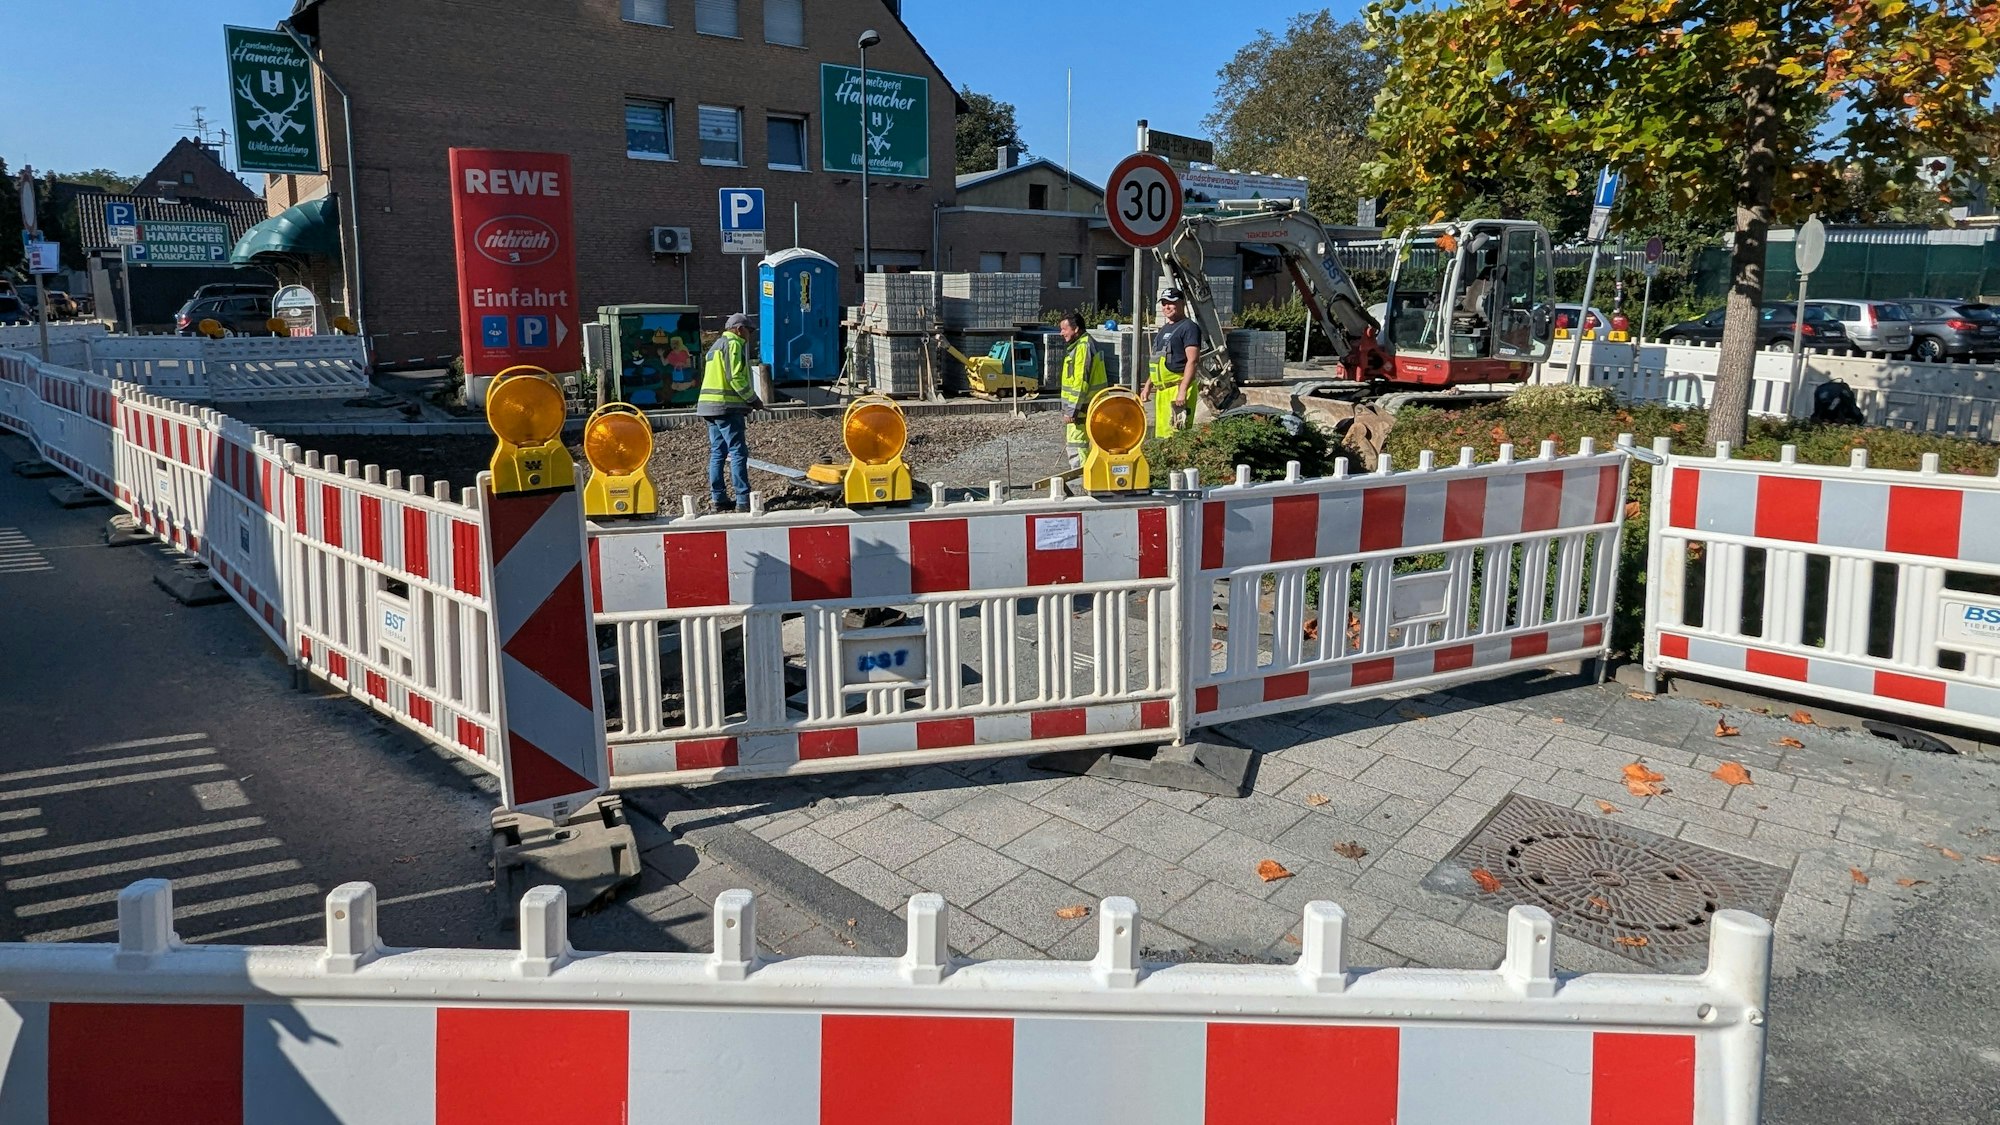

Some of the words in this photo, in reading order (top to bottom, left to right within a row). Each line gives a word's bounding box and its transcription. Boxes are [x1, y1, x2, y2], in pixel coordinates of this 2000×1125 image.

[239, 39, 294, 54] Landmetzgerei
[232, 47, 308, 67] Hamacher
[844, 71, 902, 92] Lanmetzgerei
[248, 141, 309, 157] Wildveredelung
[851, 153, 904, 172] Wilveredelung
[465, 168, 560, 197] REWE
[1124, 180, 1166, 222] 30
[113, 206, 128, 224] P
[731, 193, 753, 228] P
[145, 224, 223, 233] LANDMETZGEREI
[146, 232, 224, 243] HAMACHER
[484, 229, 550, 248] richrath
[132, 245, 145, 258] P
[150, 244, 206, 253] KUNDEN
[151, 252, 207, 260] PARKPLATZ
[211, 246, 223, 259] P
[1322, 258, 1346, 285] BST
[473, 288, 568, 307] Einfahrt
[523, 318, 542, 345] P
[385, 610, 406, 632] BST
[1965, 606, 2000, 623] BS
[1963, 622, 2000, 631] TIEFB
